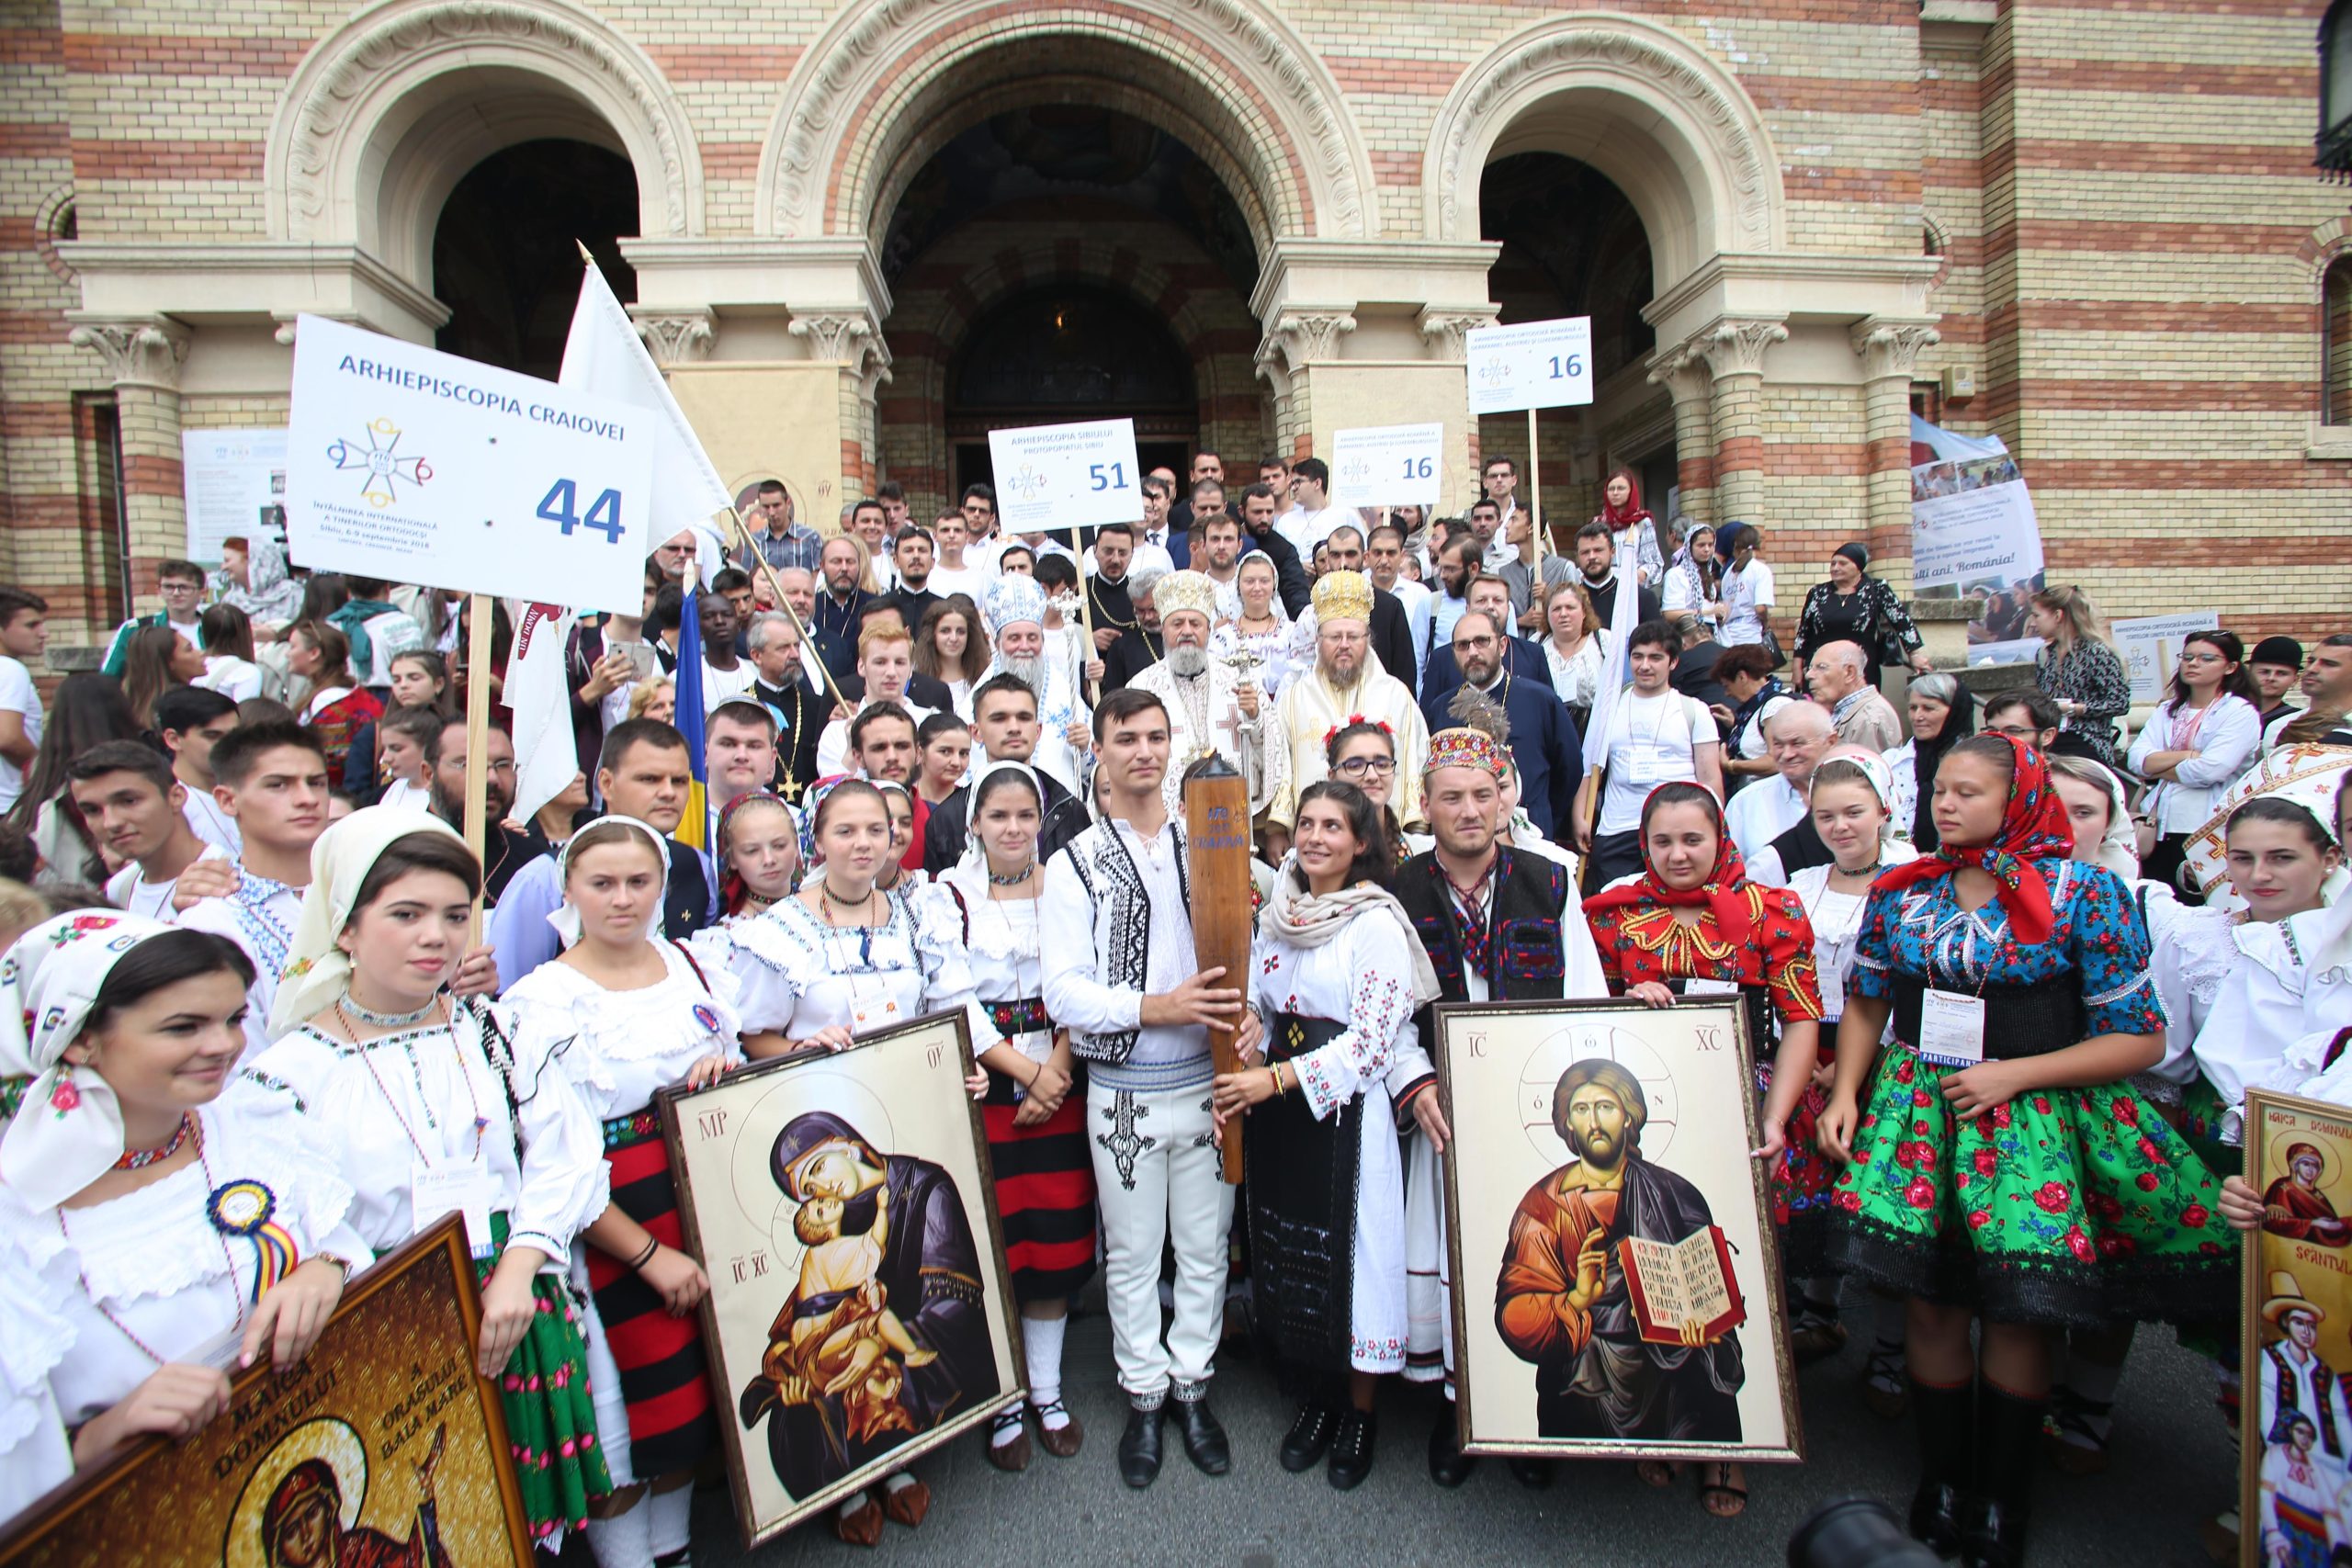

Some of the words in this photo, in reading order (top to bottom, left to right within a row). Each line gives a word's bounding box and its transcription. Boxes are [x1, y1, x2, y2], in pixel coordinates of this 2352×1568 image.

[1548, 353, 1582, 379] 16
[338, 355, 523, 417] ARHIEPISCOPIA
[528, 403, 626, 442] CRAIOVEI
[1011, 432, 1076, 446] ARHIEPISCOPIA
[1077, 429, 1114, 440] SIBIULUI
[1023, 444, 1084, 456] PROTOPOPIATUL
[1090, 461, 1129, 491] 51
[1403, 457, 1432, 479] 16
[323, 514, 331, 524] A
[333, 516, 378, 531] TINERILOR
[536, 478, 626, 545] 44
[1932, 564, 1953, 577] ani,
[520, 637, 528, 651] UN
[232, 1359, 311, 1433] MAICA
[214, 1368, 336, 1480] DOMNULUI
[381, 1415, 423, 1461] BAIA
[425, 1373, 467, 1423] MARE
